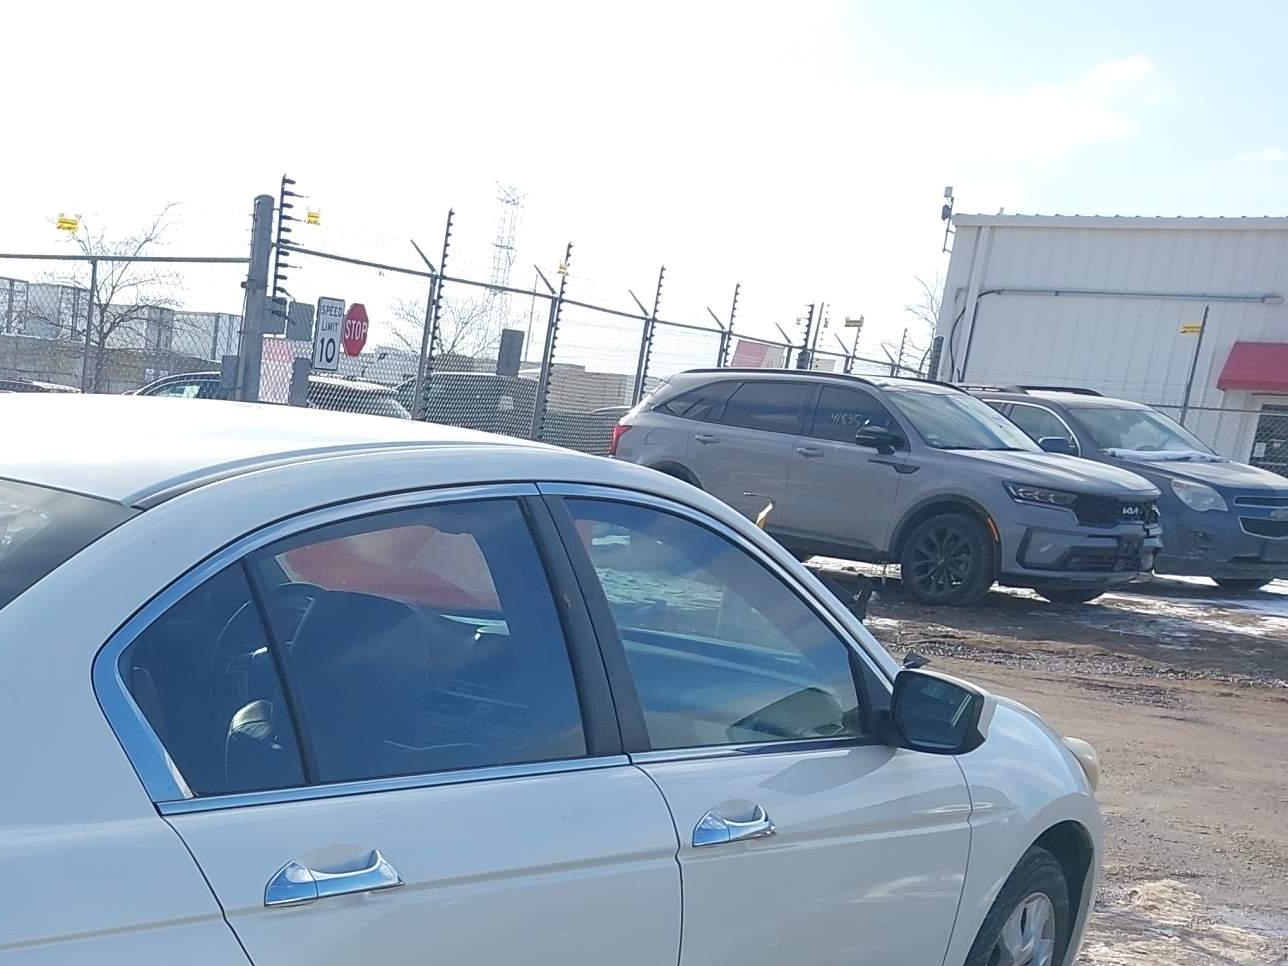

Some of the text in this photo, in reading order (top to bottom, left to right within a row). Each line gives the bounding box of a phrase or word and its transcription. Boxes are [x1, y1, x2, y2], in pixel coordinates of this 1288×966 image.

[322, 305, 343, 317] SPEED
[322, 321, 339, 332] LIMIT
[345, 319, 368, 341] STOP
[319, 336, 336, 363] 10
